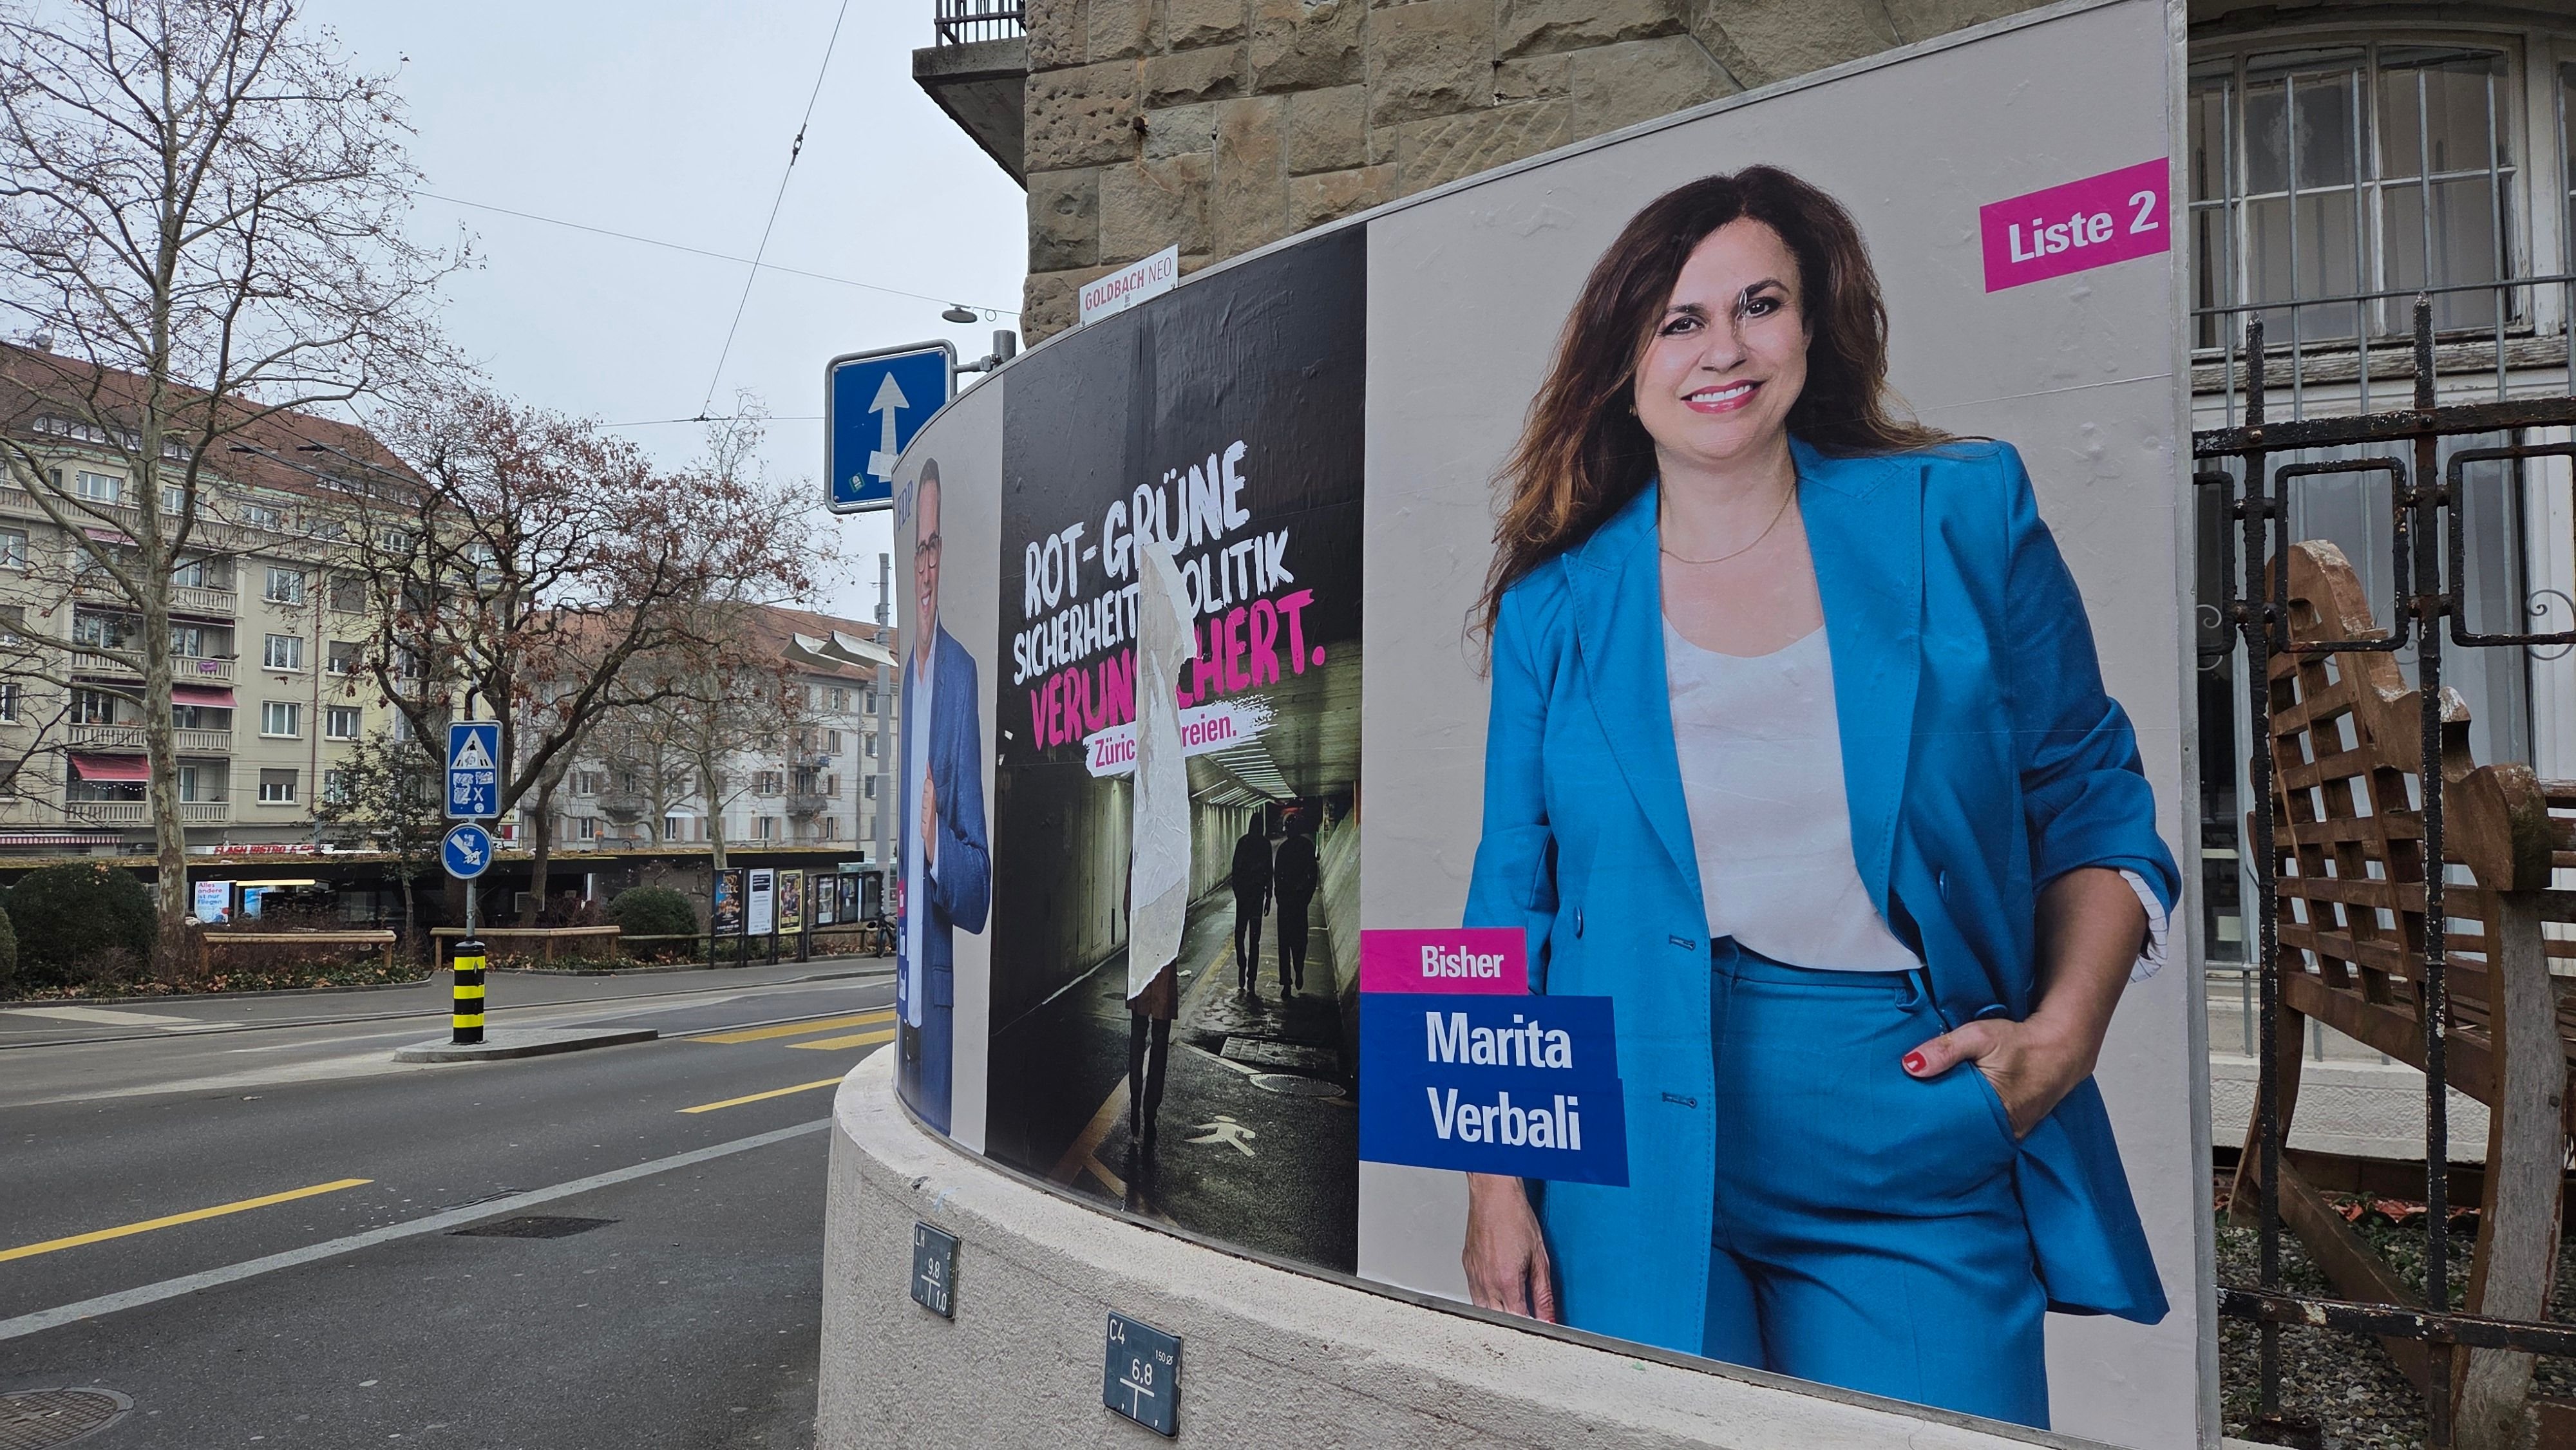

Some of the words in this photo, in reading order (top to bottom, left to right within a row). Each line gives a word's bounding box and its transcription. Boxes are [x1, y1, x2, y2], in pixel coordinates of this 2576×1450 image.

[2009, 211, 2114, 263] Liste
[2128, 190, 2159, 234] 2
[1085, 268, 1144, 311] GOLDBACH
[1148, 257, 1171, 285] NEO
[898, 480, 913, 532] FDP
[1014, 525, 1294, 686] SICHERHEITOLITIK
[1095, 733, 1135, 768] Züric
[1182, 713, 1237, 748] reien.
[1421, 945, 1504, 977] Bisher
[1426, 1012, 1572, 1069] Marita
[1426, 1087, 1581, 1151] Verbali
[927, 1257, 940, 1279] 9,8
[936, 1290, 947, 1312] 1,0
[1110, 1319, 1125, 1344] C4
[1132, 1358, 1153, 1386] 6,8
